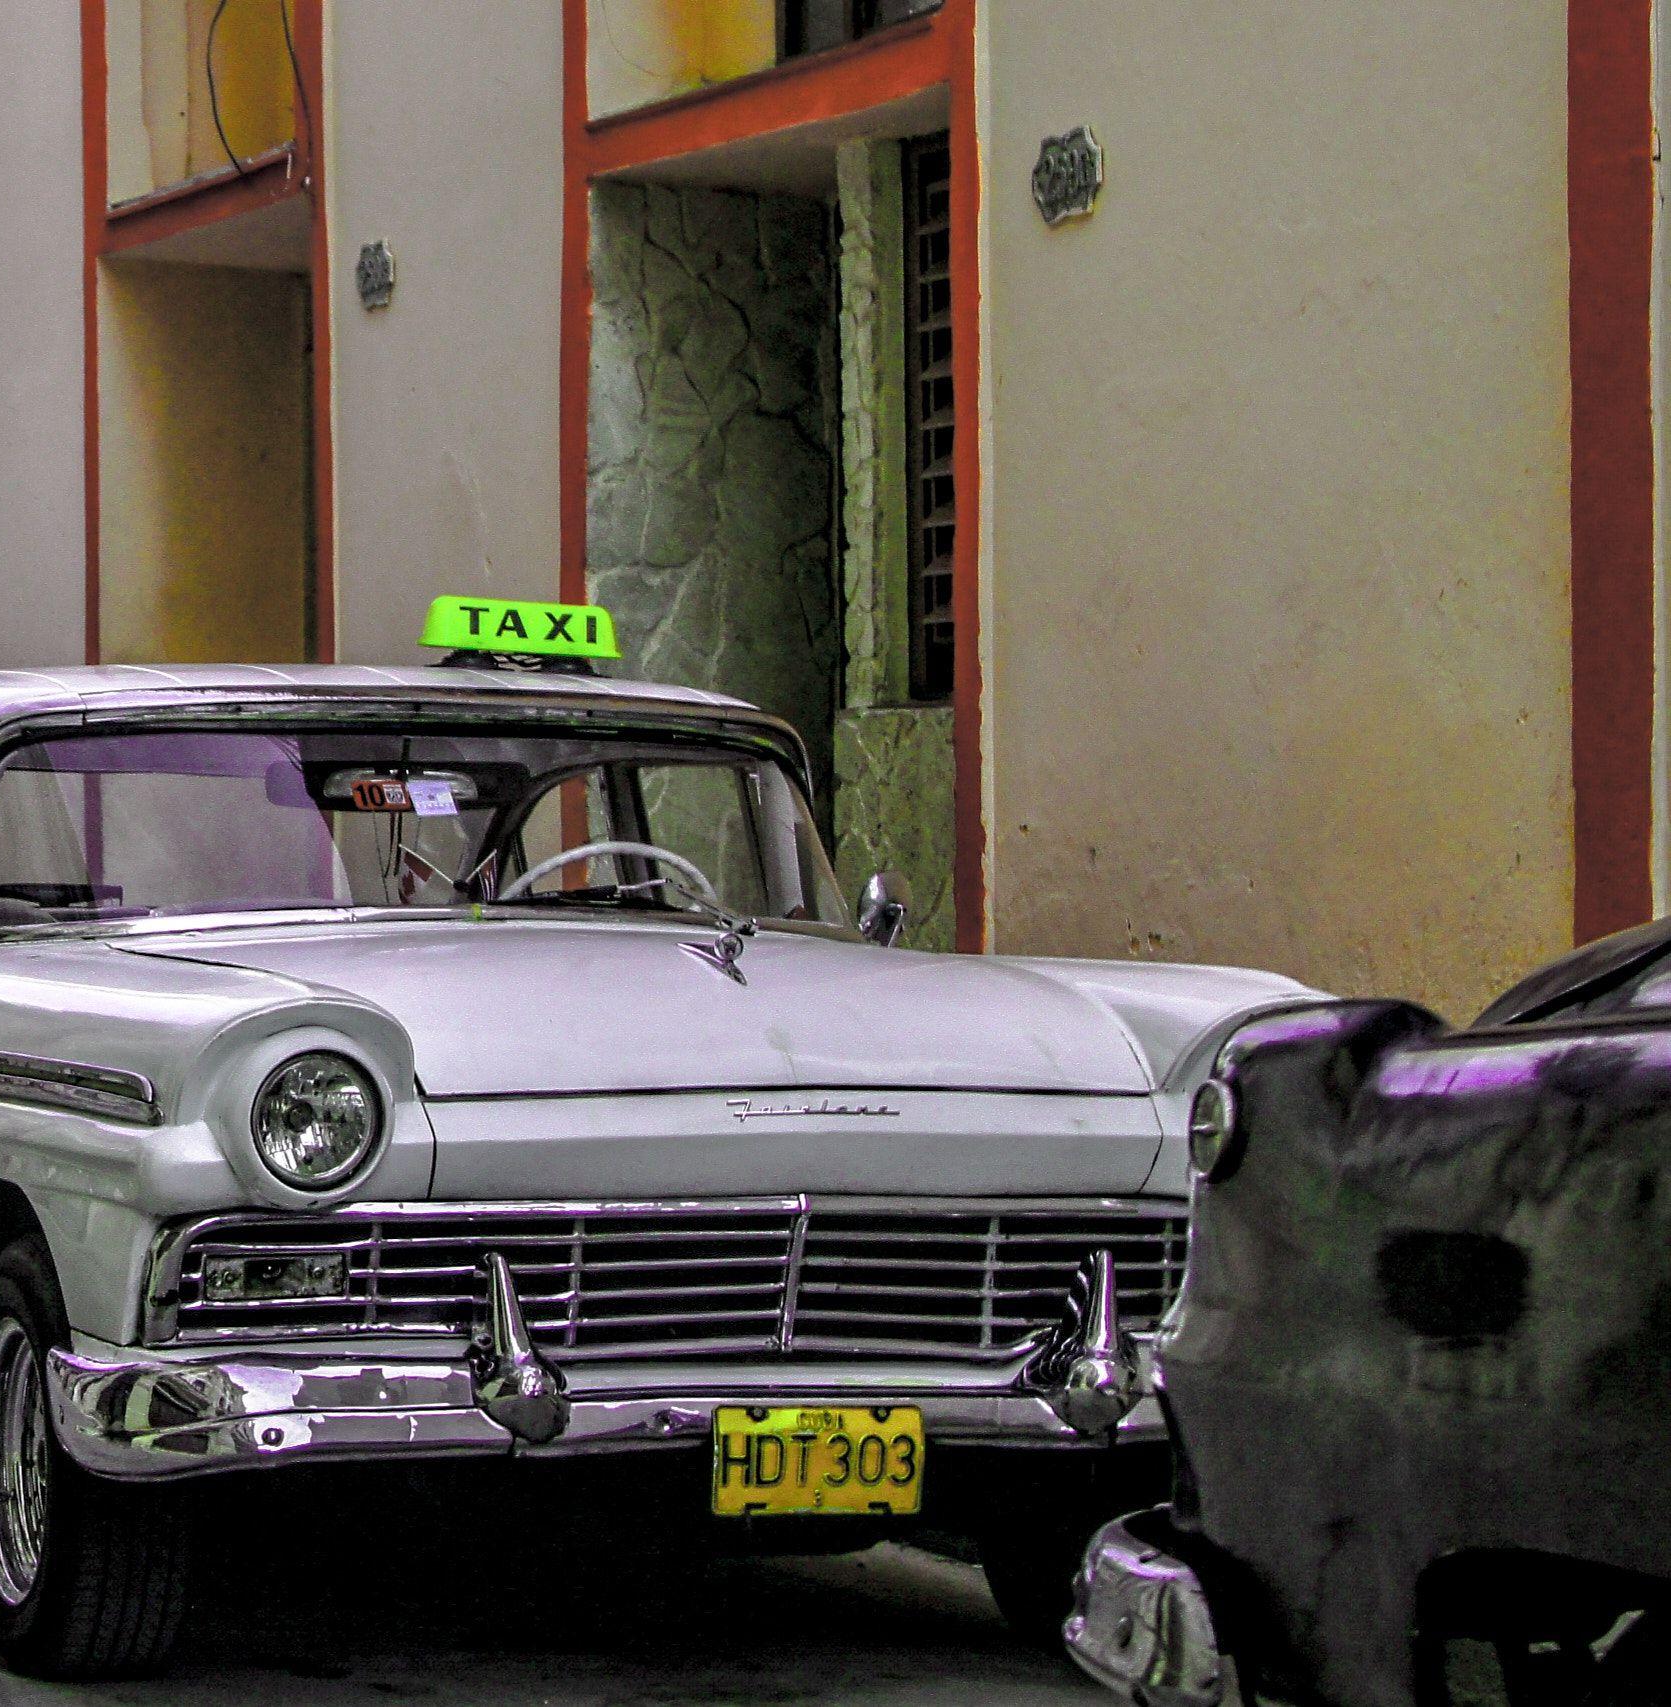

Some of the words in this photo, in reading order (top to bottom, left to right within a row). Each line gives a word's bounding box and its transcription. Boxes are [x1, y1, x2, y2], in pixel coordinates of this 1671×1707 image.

[459, 605, 598, 644] TAXI
[354, 784, 386, 807] 10
[726, 1099, 900, 1123] Fairlane
